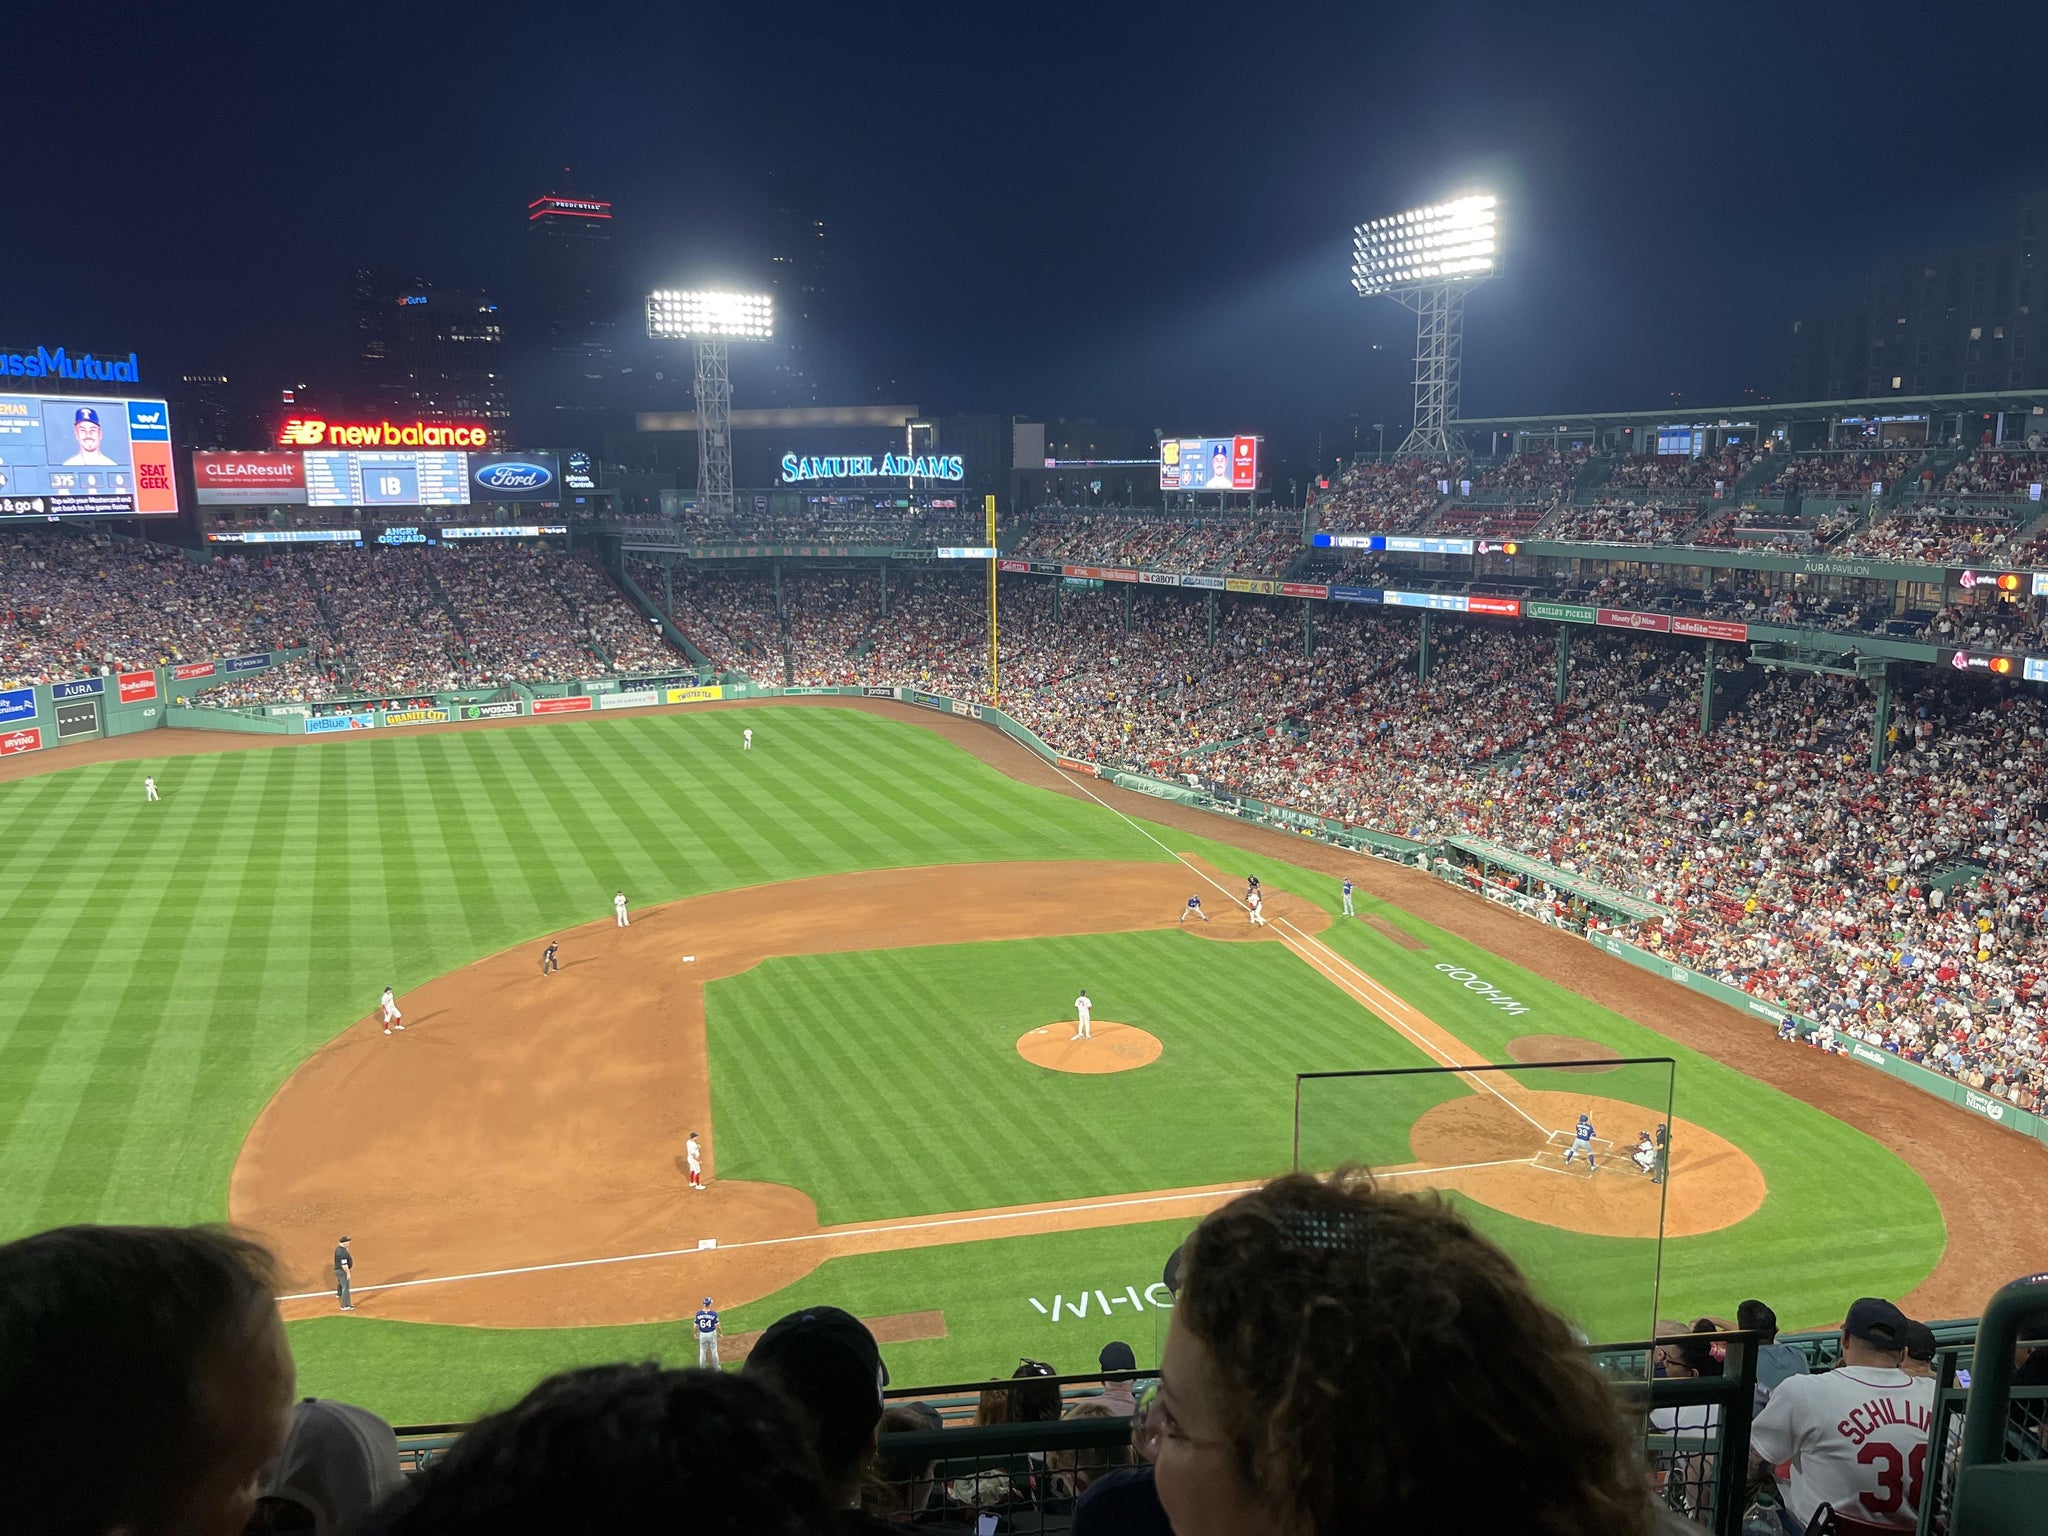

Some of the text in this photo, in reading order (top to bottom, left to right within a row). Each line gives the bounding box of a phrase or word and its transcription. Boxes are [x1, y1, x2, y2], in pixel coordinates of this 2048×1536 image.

[555, 201, 600, 210] PRUDENTIAL
[330, 426, 381, 445] new
[383, 421, 487, 446] balance
[140, 464, 166, 477] SEAT
[206, 464, 294, 475] CLEAResult
[781, 451, 964, 483] SAMUEL ADAMS
[490, 467, 537, 486] Ford
[140, 477, 170, 490] GEEK
[569, 480, 595, 488] Controls
[15, 501, 31, 514] go
[385, 527, 418, 536] ANGRY
[377, 534, 427, 543] ORCHARD
[1339, 537, 1371, 548] UNITED
[1832, 564, 1870, 576] PAVILION
[1537, 606, 1592, 619] GRILLO'S PICKLES
[1611, 614, 1656, 626] Ninety Nine
[1674, 621, 1708, 634] Safelite
[191, 664, 214, 676] TICKET
[120, 680, 154, 691] Safelite
[677, 691, 701, 701] TWISTED
[143, 708, 156, 717] 420
[480, 703, 517, 715] wasabi
[59, 714, 94, 724] VOLVO
[387, 709, 448, 724] GRANITE CITY
[309, 719, 345, 731] jetBlue
[4, 735, 35, 748] IRVING
[1434, 963, 1530, 1015] WHOOP
[1966, 1090, 1988, 1105] Ninety
[1966, 1098, 1986, 1112] Nine
[700, 1319, 712, 1328] 64
